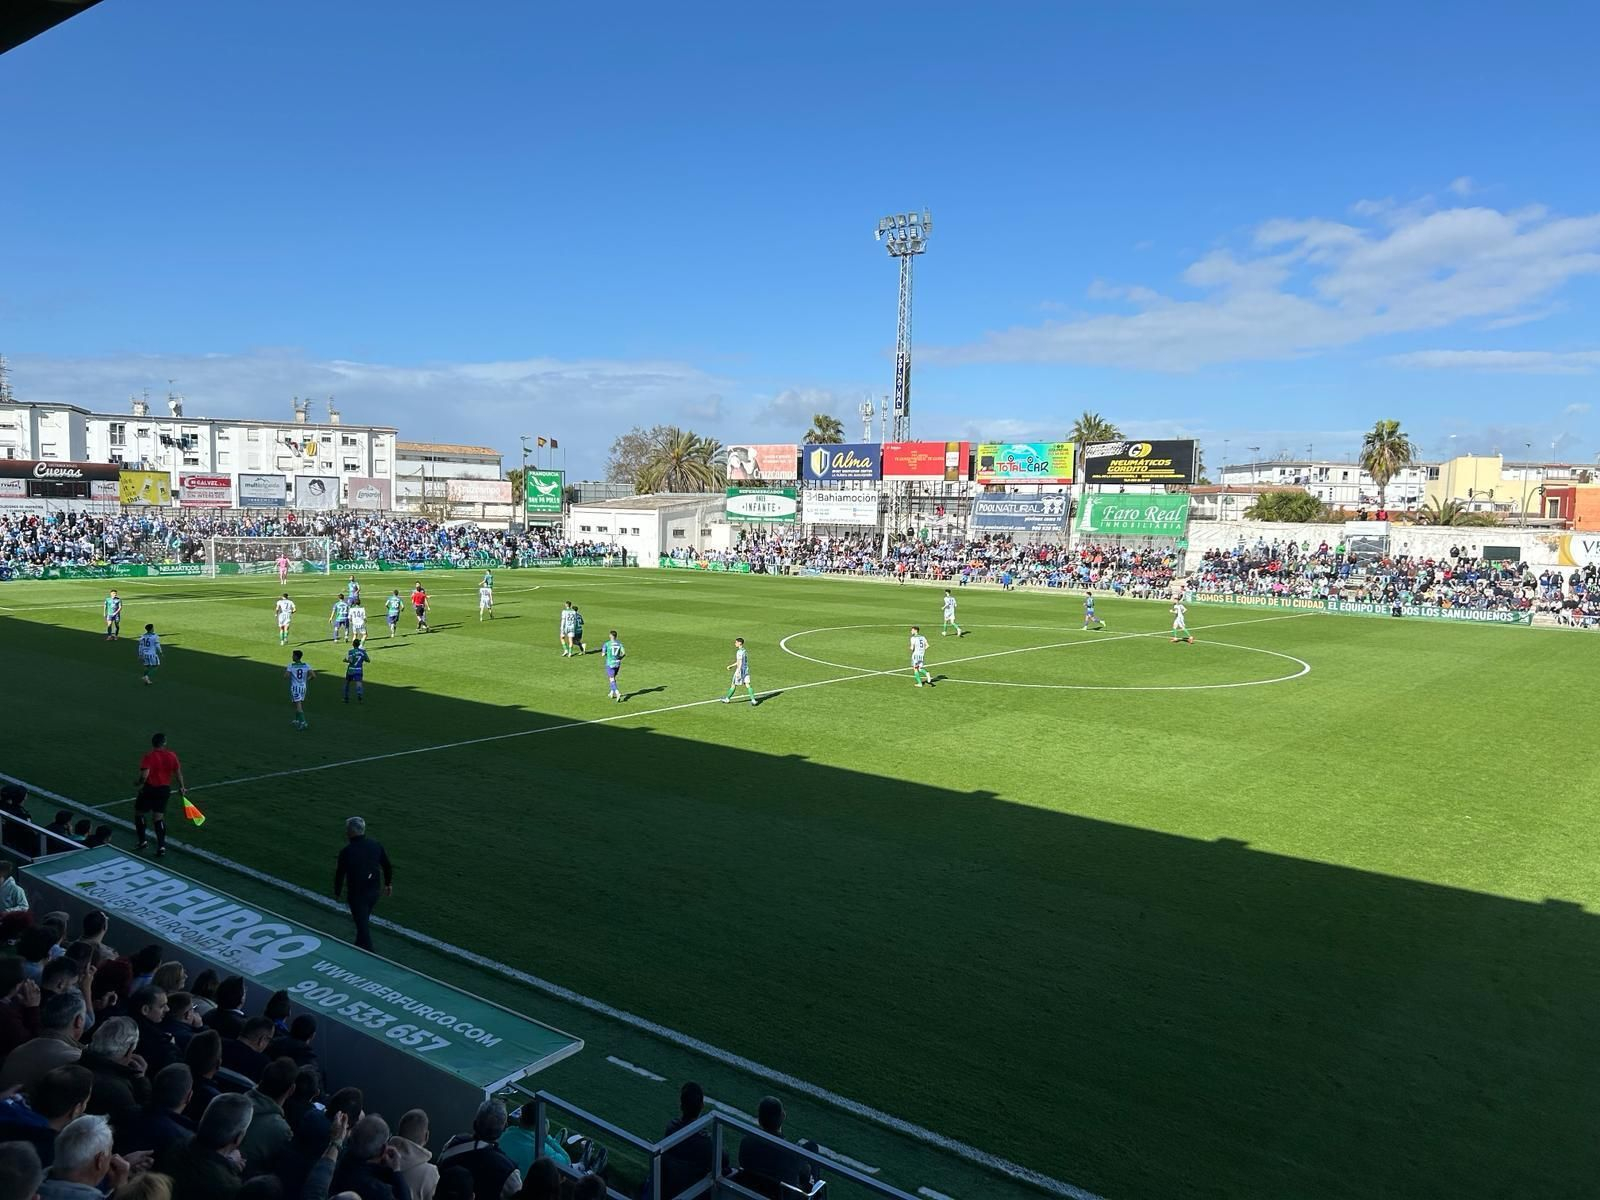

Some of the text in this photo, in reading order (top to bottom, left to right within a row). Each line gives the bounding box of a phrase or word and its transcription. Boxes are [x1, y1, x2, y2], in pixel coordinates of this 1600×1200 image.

[832, 451, 873, 468] Alma
[1026, 461, 1049, 472] CAR
[33, 462, 83, 478] Cuevas
[745, 502, 776, 512] INFANTE
[1103, 504, 1188, 523] Faro Real
[1100, 521, 1181, 529] INMOBILIARIA
[1196, 593, 1224, 602] SOMOS
[1225, 595, 1235, 603] EL
[1236, 596, 1266, 606] EQUIPO
[1268, 598, 1279, 607] DE
[1280, 599, 1291, 607] TU
[1328, 602, 1338, 611] EL
[1340, 602, 1372, 613] EQUIPO
[1375, 604, 1387, 614] DE
[1389, 605, 1419, 616] TDOS
[1421, 607, 1439, 617] LOS
[142, 637, 150, 648] 16
[919, 639, 924, 648] 5
[611, 645, 620, 656] 17
[354, 655, 362, 666] 7
[296, 668, 303, 680] 8
[82, 856, 322, 960] IBERFURGO
[134, 905, 158, 918] DE
[154, 914, 242, 958] FURGONETAS
[311, 960, 503, 1048] WWW.IBERFURGO.COM
[287, 979, 452, 1052] 900 533 657
